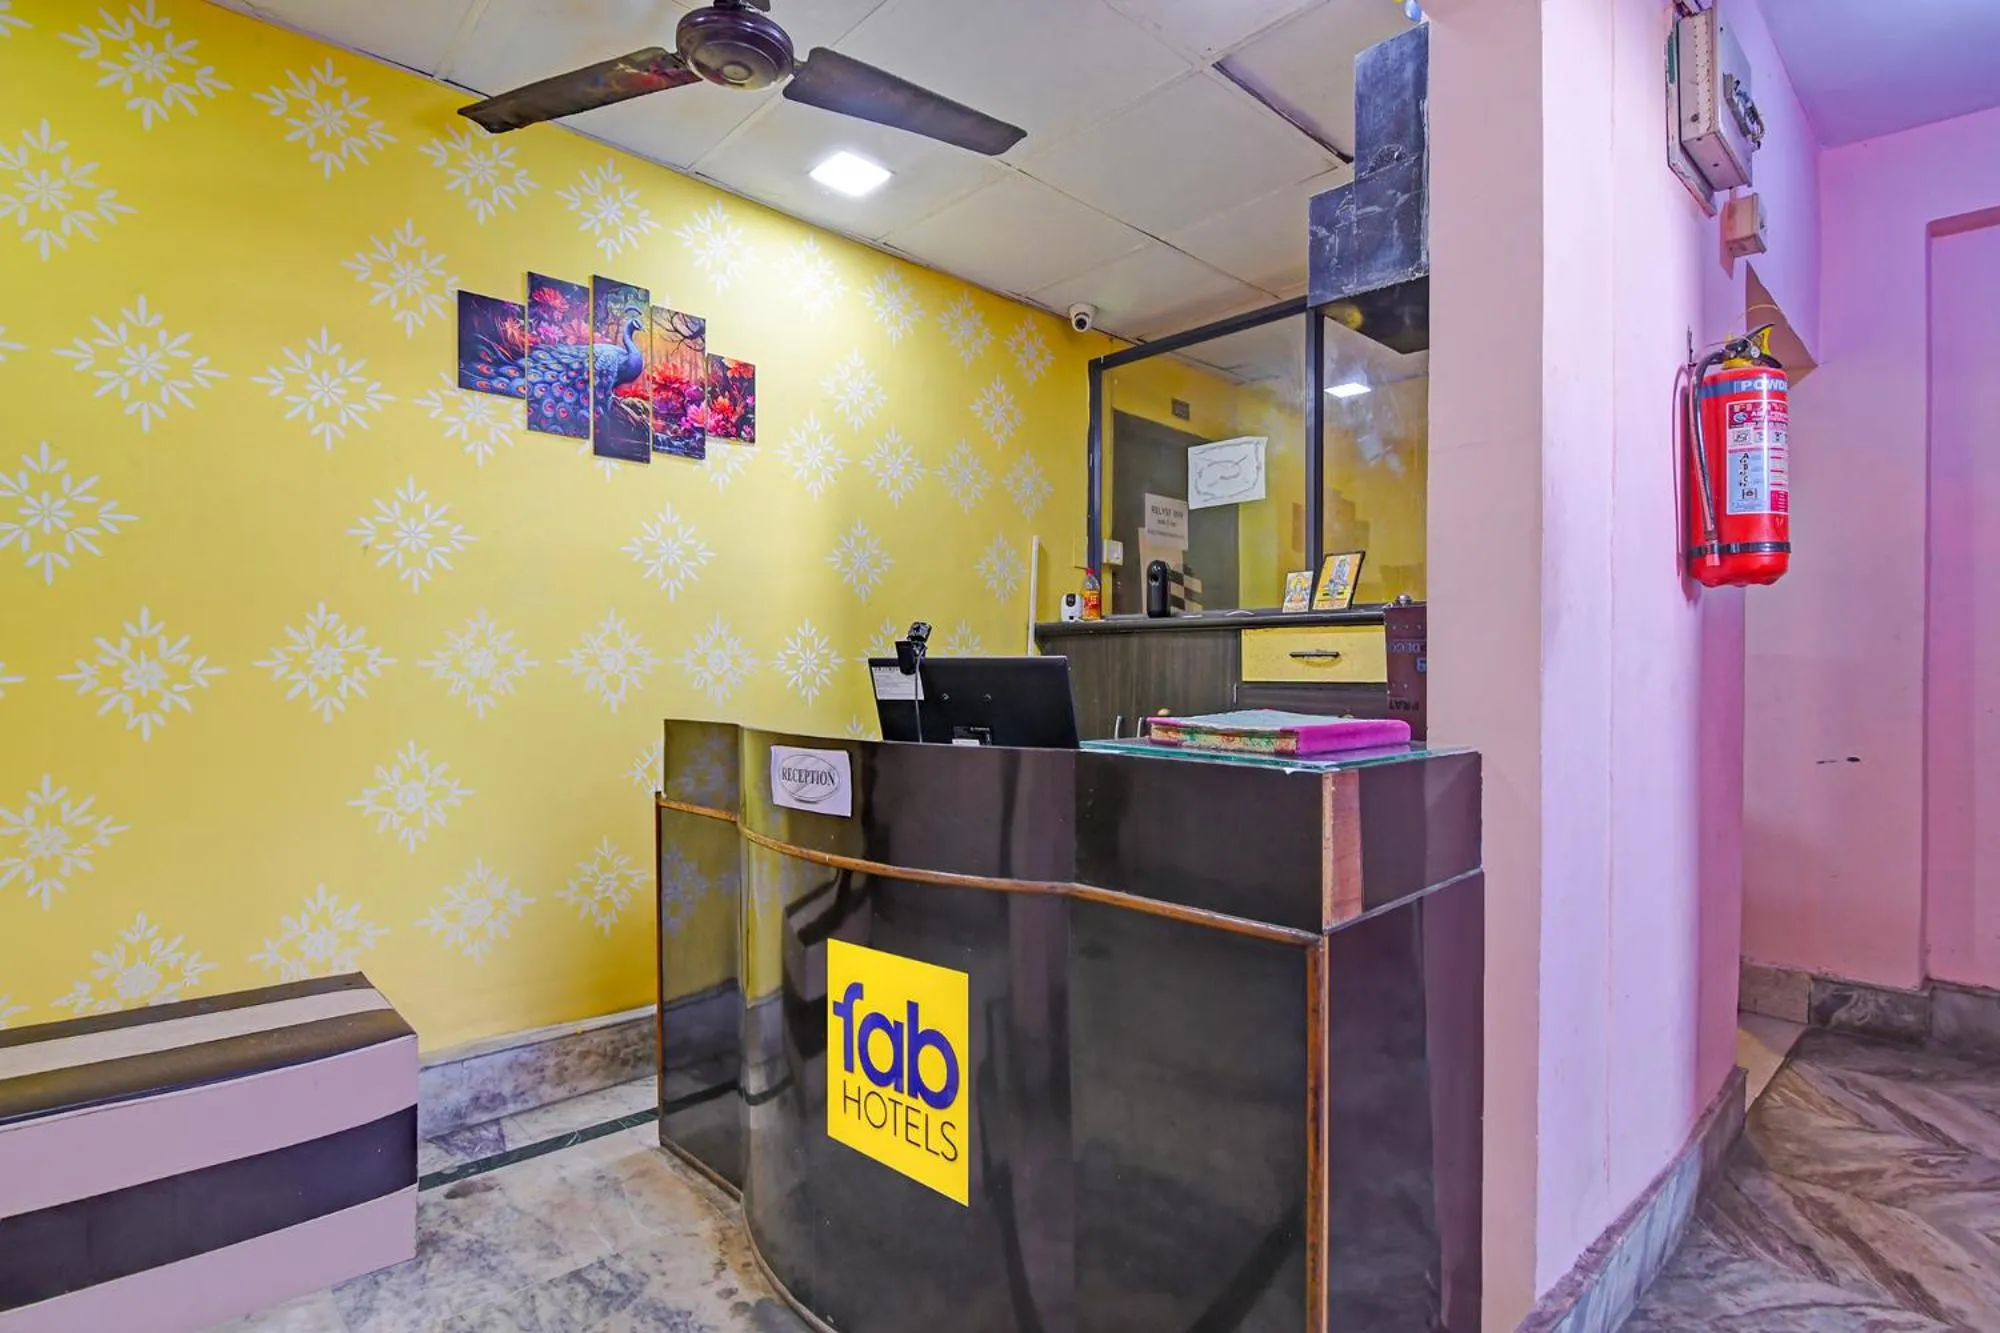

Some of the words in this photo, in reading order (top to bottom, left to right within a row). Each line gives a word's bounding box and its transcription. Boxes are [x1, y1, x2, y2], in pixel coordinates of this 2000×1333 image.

[781, 767, 836, 786] RECEPTION
[832, 981, 960, 1110] fab
[843, 1079, 959, 1163] HOTELS
